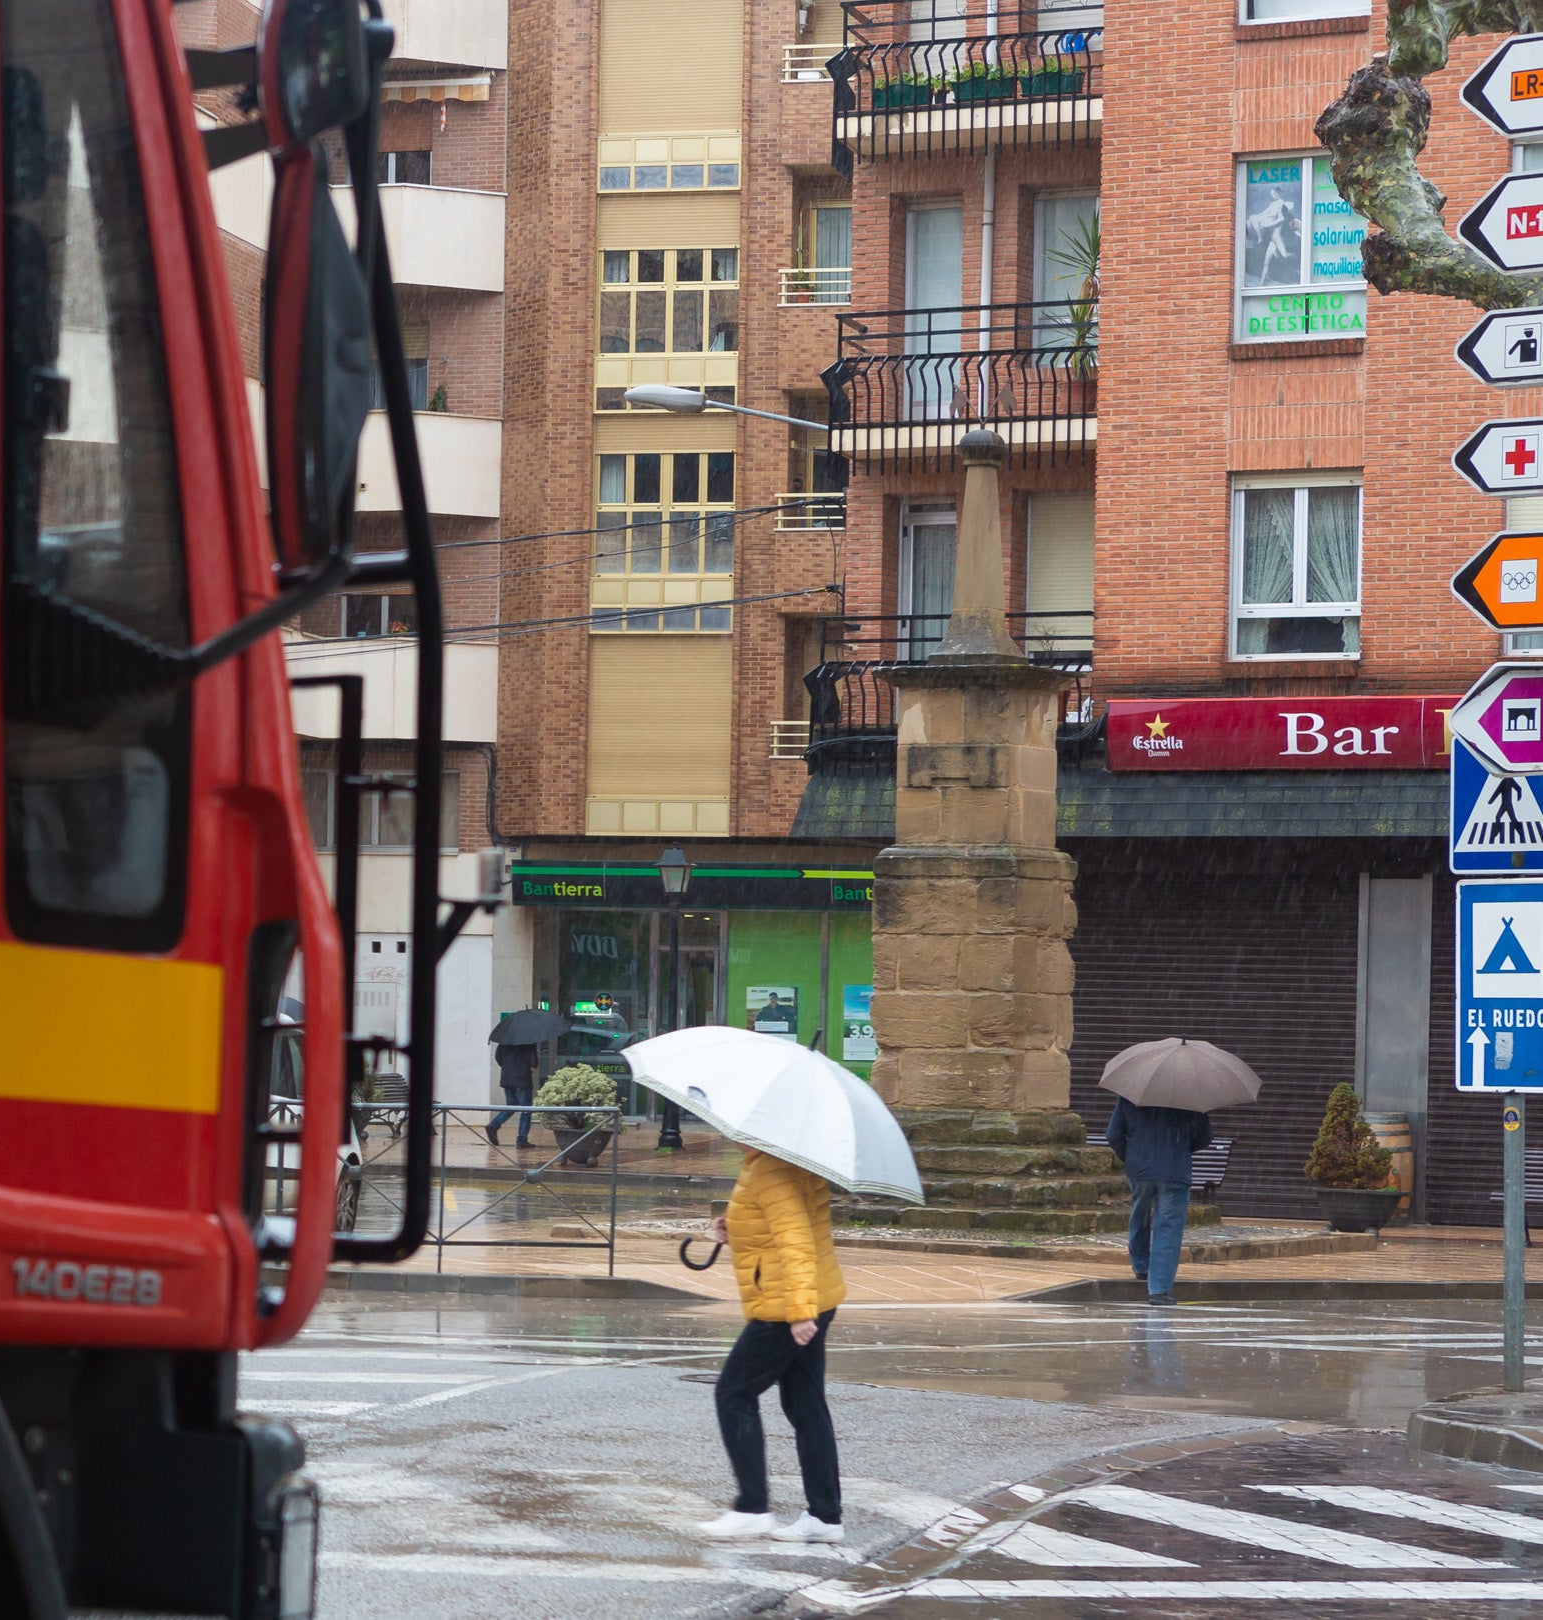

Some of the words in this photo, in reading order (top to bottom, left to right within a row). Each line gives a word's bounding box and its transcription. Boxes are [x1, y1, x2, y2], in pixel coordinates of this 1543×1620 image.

[1249, 167, 1301, 184] LASER
[1313, 226, 1365, 247] solarium
[1269, 294, 1344, 312] CENTRO
[1249, 317, 1272, 333] DE
[1132, 735, 1184, 751] Estrella
[1278, 712, 1400, 756] Bar
[522, 881, 603, 897] Bantierra
[1468, 1009, 1486, 1027] EL
[12, 1257, 163, 1306] 140E28
